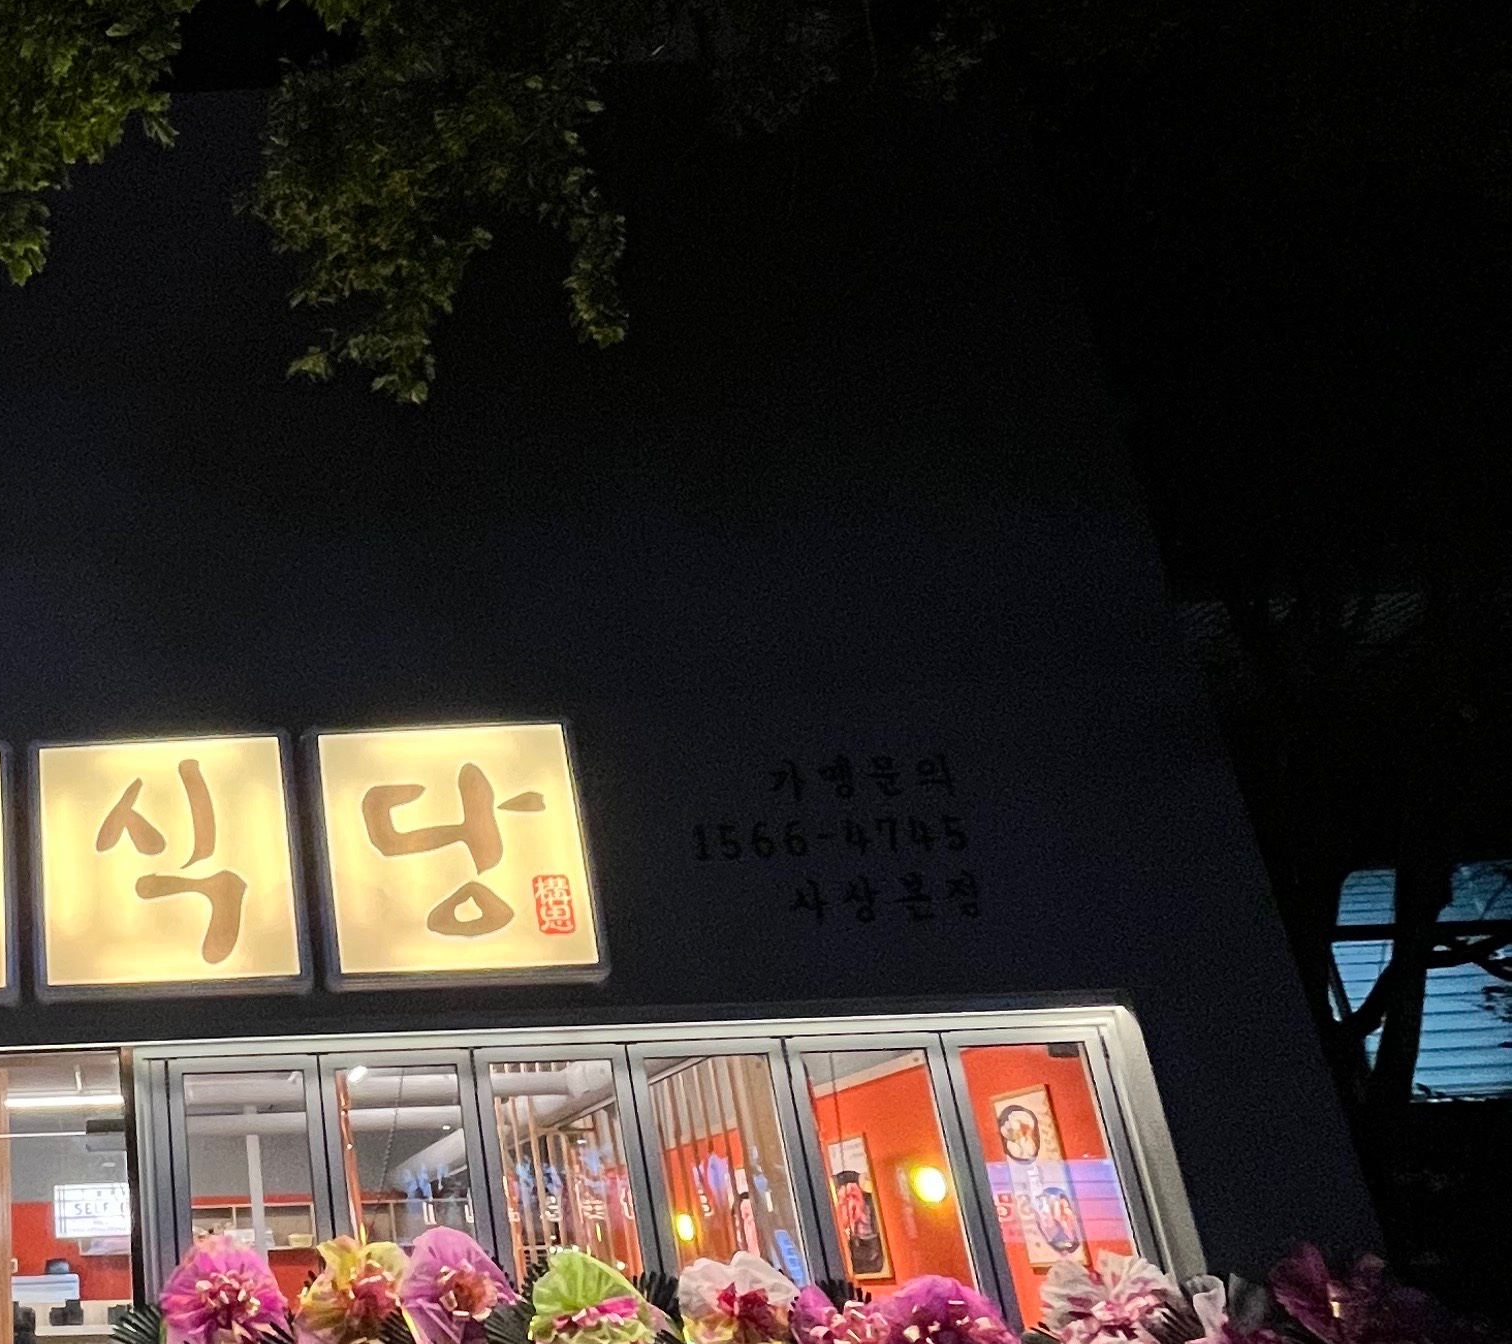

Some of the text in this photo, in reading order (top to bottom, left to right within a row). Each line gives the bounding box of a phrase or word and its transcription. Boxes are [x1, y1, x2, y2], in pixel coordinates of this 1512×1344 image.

[770, 754, 957, 802] 가맹문의
[692, 816, 969, 861] 1566-4745
[74, 1202, 110, 1216] SELF
